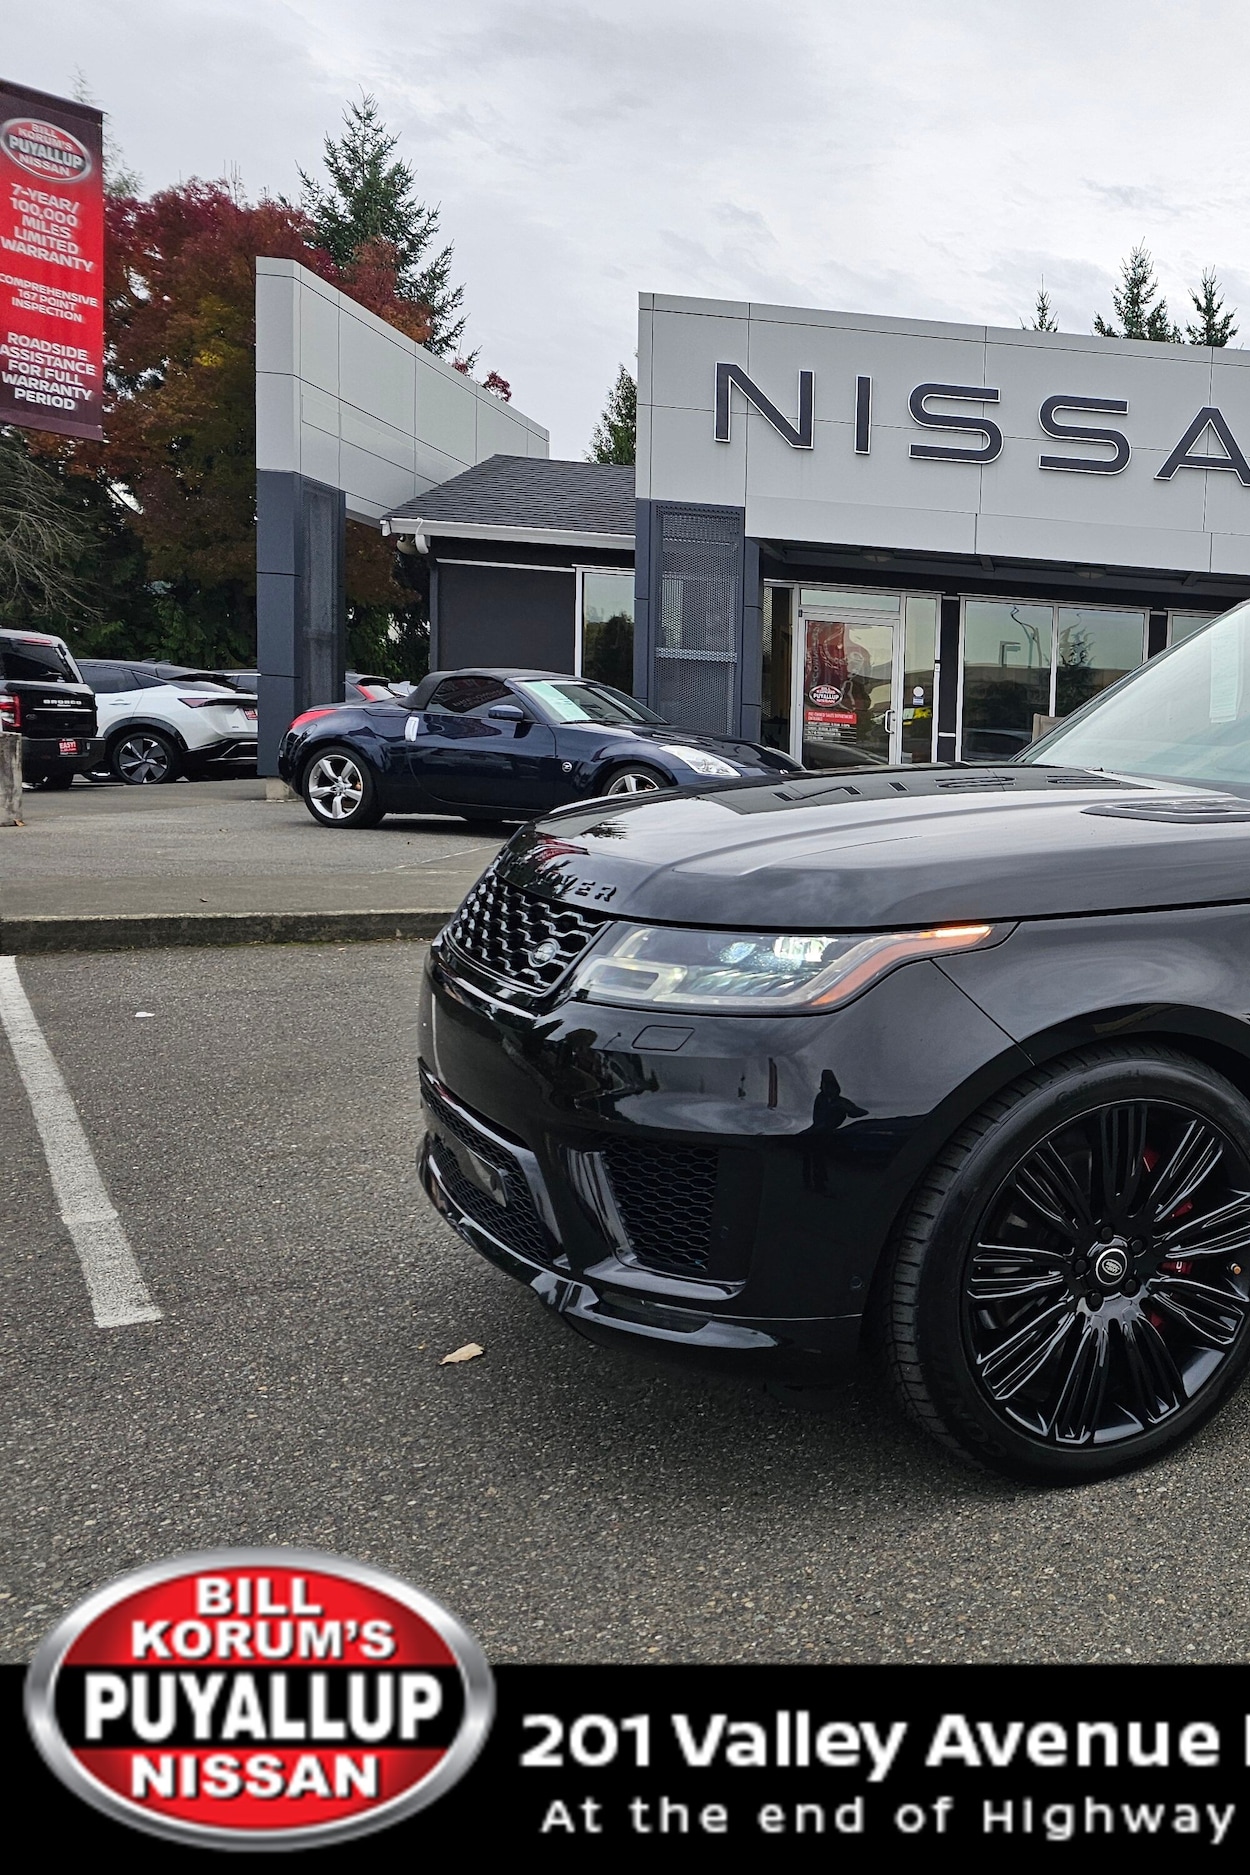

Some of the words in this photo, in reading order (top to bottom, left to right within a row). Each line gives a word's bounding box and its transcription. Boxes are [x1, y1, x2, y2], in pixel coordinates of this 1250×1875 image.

[18, 127, 73, 150] KORUM'S
[32, 122, 57, 139] BILL
[9, 134, 84, 167] PUYALLUP
[19, 153, 70, 176] NISSAN
[10, 197, 78, 227] 100,000
[11, 182, 80, 214] 7-YEAR/
[14, 226, 79, 254] LIMITED
[22, 214, 72, 239] MILES
[1, 236, 94, 272] WARRANTY
[0, 273, 98, 307] COMPREHENSIVE
[18, 288, 37, 301] 167
[39, 294, 77, 311] POINT
[12, 297, 83, 323] INSPECTION
[0, 344, 96, 376] ASSISTANCE
[7, 331, 88, 361] ROADSIDE
[1, 371, 93, 401] WARRANTY
[8, 359, 41, 377] FOR
[44, 370, 84, 386] FULL
[14, 387, 76, 411] PERIOD
